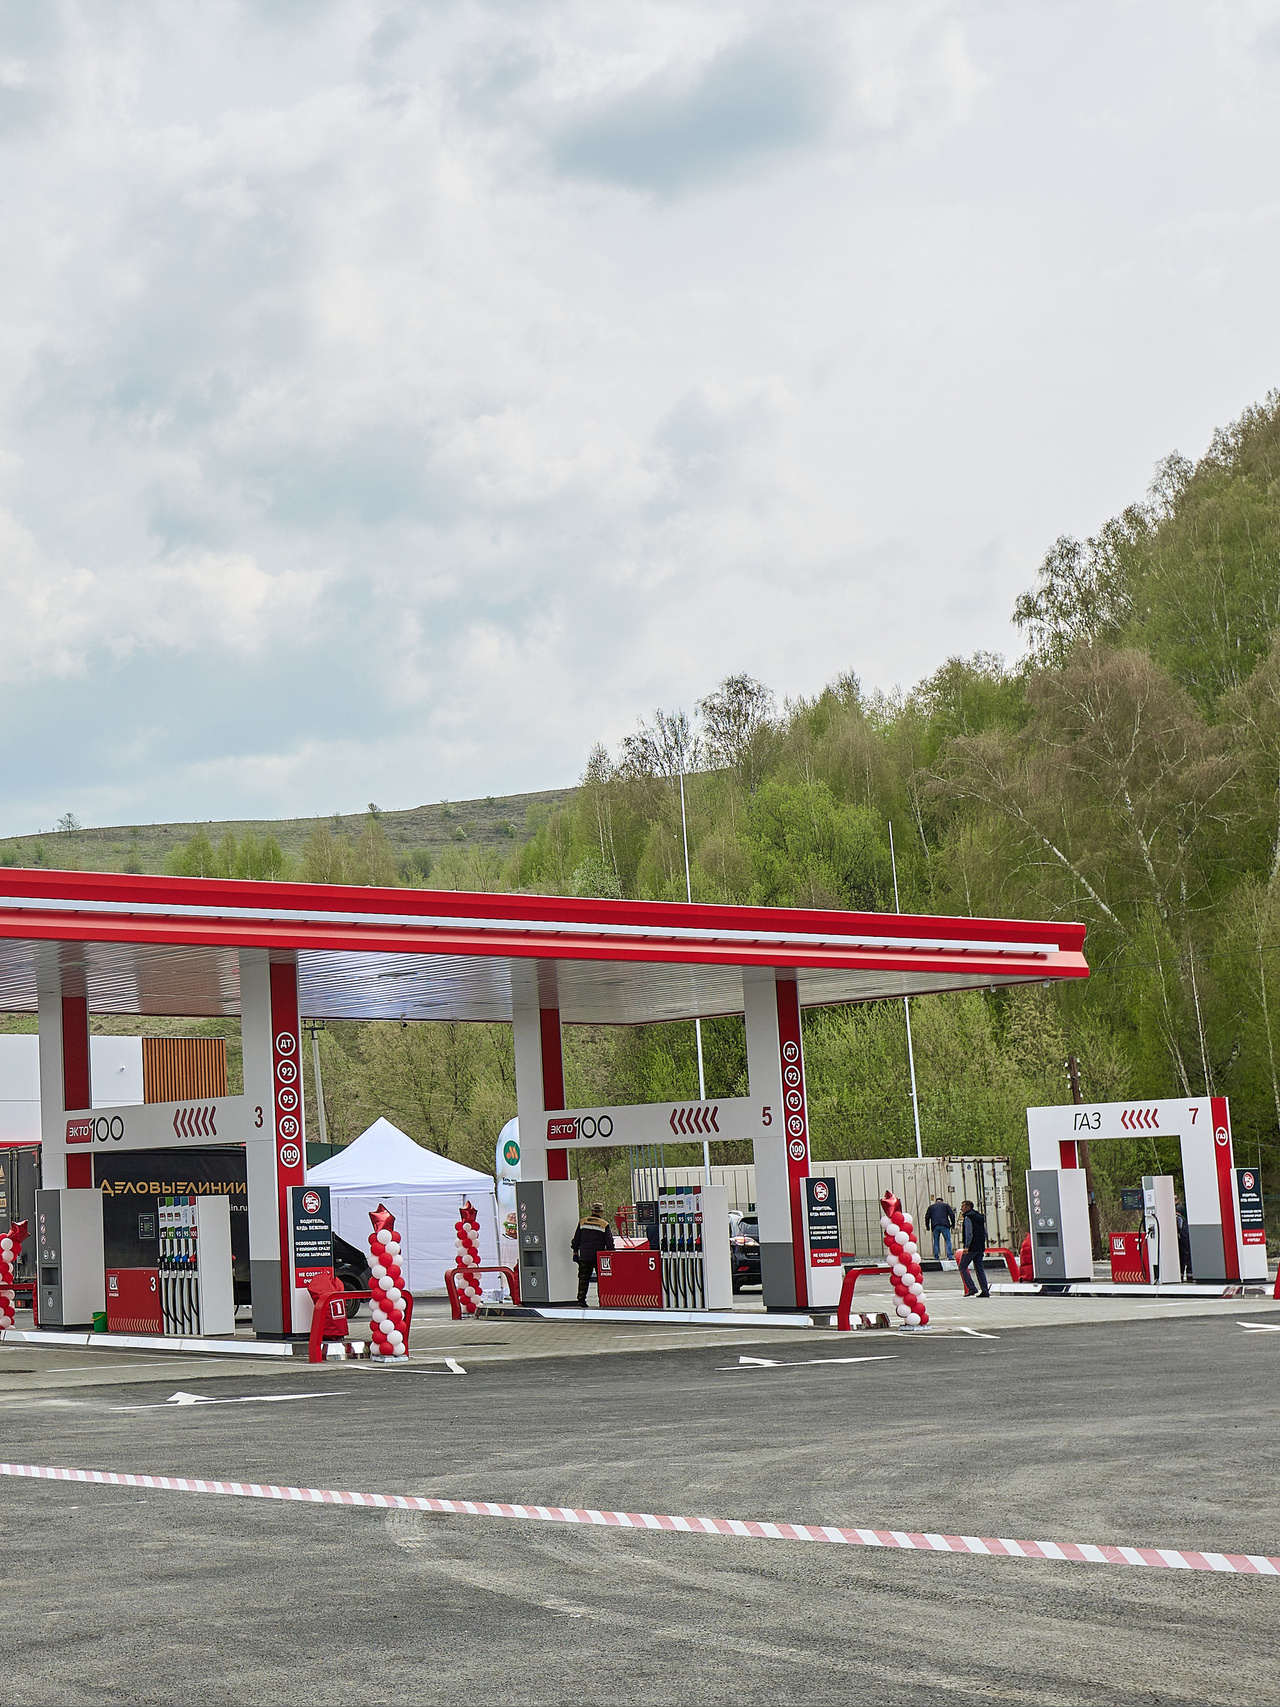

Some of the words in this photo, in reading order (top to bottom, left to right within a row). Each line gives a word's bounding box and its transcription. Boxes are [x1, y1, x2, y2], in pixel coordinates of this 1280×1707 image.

[281, 1040, 291, 1048] ДТ
[786, 1048, 795, 1056] ДТ
[281, 1067, 293, 1076] 92
[788, 1072, 797, 1080] 92
[283, 1095, 294, 1104] 95
[790, 1096, 798, 1105] 95
[254, 1106, 264, 1128] 3
[762, 1106, 772, 1126] 5
[1189, 1108, 1199, 1125] 7
[284, 1121, 294, 1130] 95
[792, 1120, 800, 1128] 95
[1073, 1112, 1102, 1131] ГАЗ
[69, 1126, 89, 1137] ЭКТО
[90, 1115, 124, 1142] 100
[550, 1124, 573, 1135] ЭКТО
[574, 1115, 613, 1139] 100
[1216, 1132, 1226, 1140] ГАЗ
[791, 1145, 803, 1153] 100
[283, 1150, 297, 1158] 100
[229, 1203, 248, 1212] in.ru
[649, 1257, 656, 1270] 5
[150, 1276, 156, 1291] 3
